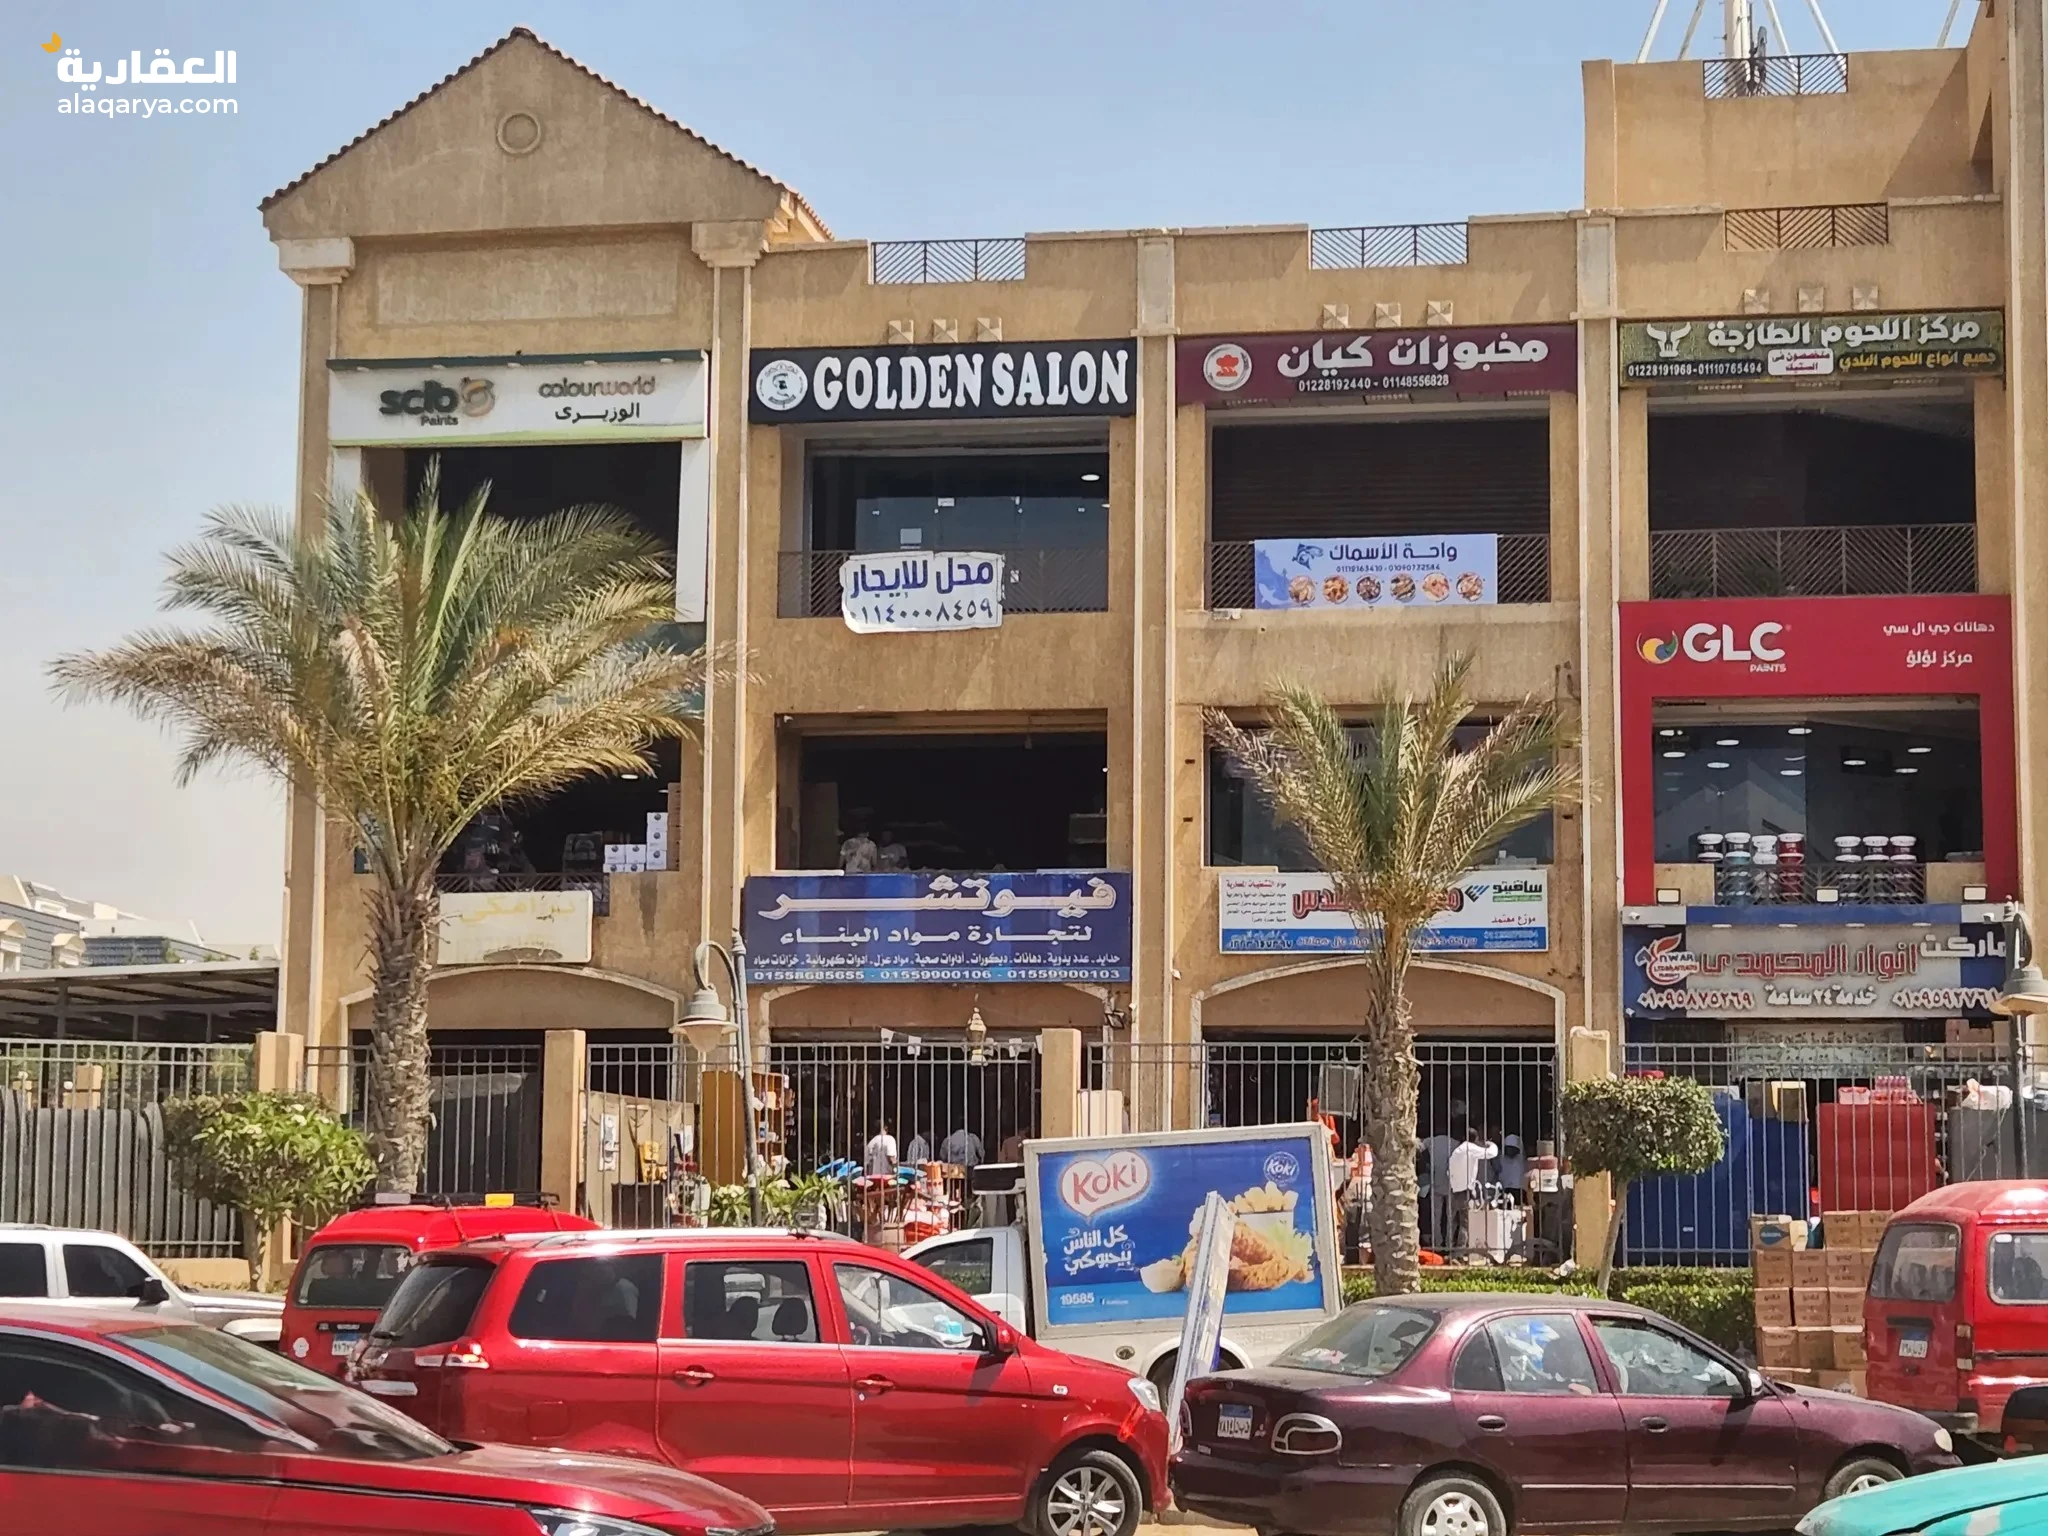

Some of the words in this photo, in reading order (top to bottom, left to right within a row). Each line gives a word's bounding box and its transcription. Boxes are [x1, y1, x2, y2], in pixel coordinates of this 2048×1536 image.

[1707, 321, 1811, 353] الطازجة
[1821, 316, 1911, 348] اللحوم
[1917, 315, 1980, 344] مركز
[1276, 335, 1374, 378] كيان
[1388, 331, 1550, 372] مخبوزات
[1881, 352, 1923, 370] اللحوم
[538, 375, 656, 398] colourworld
[813, 352, 984, 410] GOLDEN
[991, 349, 1130, 408] SALON
[1329, 542, 1398, 560] الأسماك
[1402, 541, 1458, 561] واحة
[935, 557, 994, 594] محل
[1883, 624, 1909, 637] سي
[1912, 621, 1925, 636] ال
[1928, 624, 1951, 636] جي
[1953, 621, 1996, 633] دهانات
[1682, 621, 1786, 662] GLC
[1749, 663, 1787, 673] PAINTS
[1906, 649, 1937, 668] لؤلؤ
[1941, 650, 1973, 668] مركز
[757, 874, 1117, 921] فيوتشر
[780, 927, 880, 947] البناء
[887, 926, 961, 946] مواد
[967, 925, 1092, 945] لتجارة
[771, 954, 800, 967] خزانات
[914, 952, 940, 966] صحية
[970, 952, 1009, 966] ديكورات
[1014, 952, 1042, 964] دهانات
[1854, 942, 1918, 982] انوار
[1764, 984, 1812, 1006] ساعة
[1832, 985, 1878, 1006] خدمة
[1063, 1229, 1102, 1255] الناس
[1103, 1224, 1129, 1248] كل
